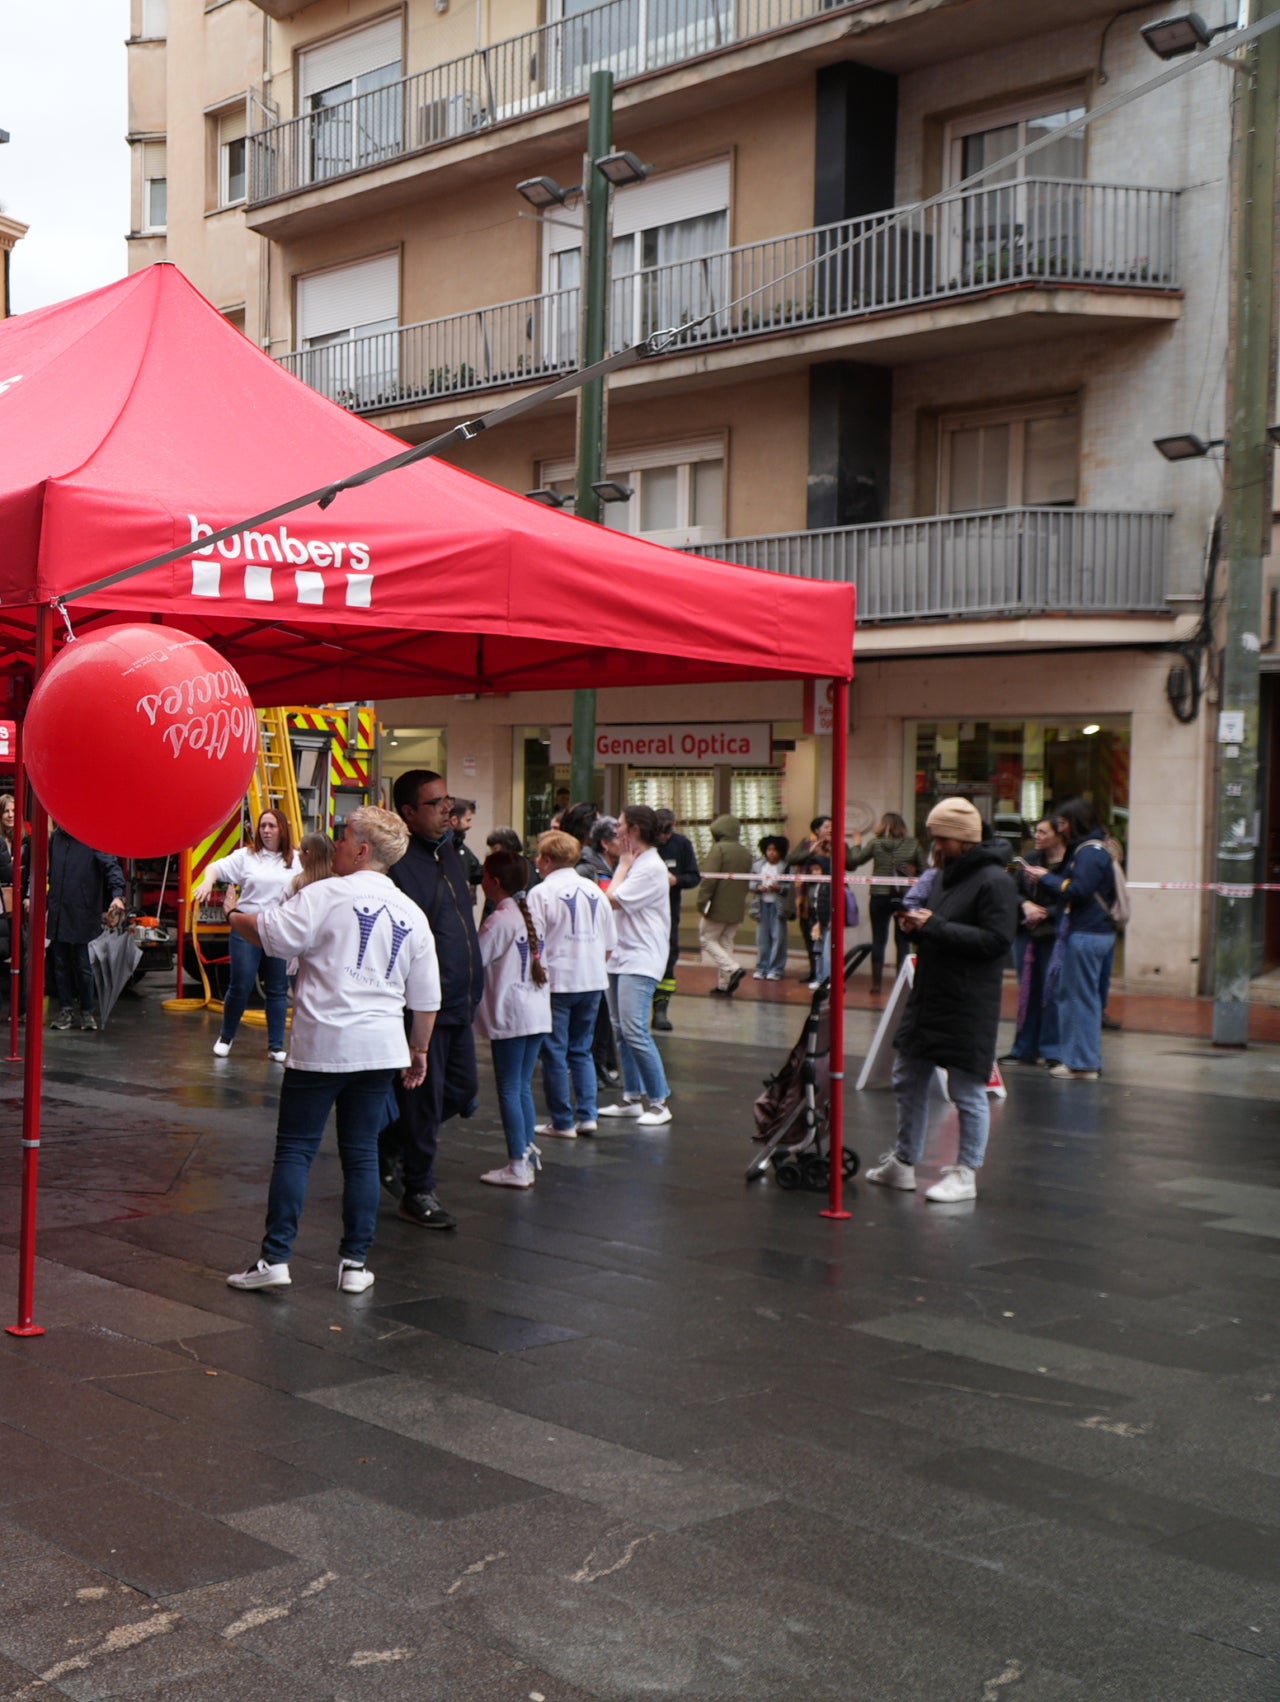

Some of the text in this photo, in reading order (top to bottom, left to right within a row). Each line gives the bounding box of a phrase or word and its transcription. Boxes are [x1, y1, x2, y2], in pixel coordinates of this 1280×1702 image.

[187, 513, 371, 571] bombers
[596, 732, 751, 760] General Optica
